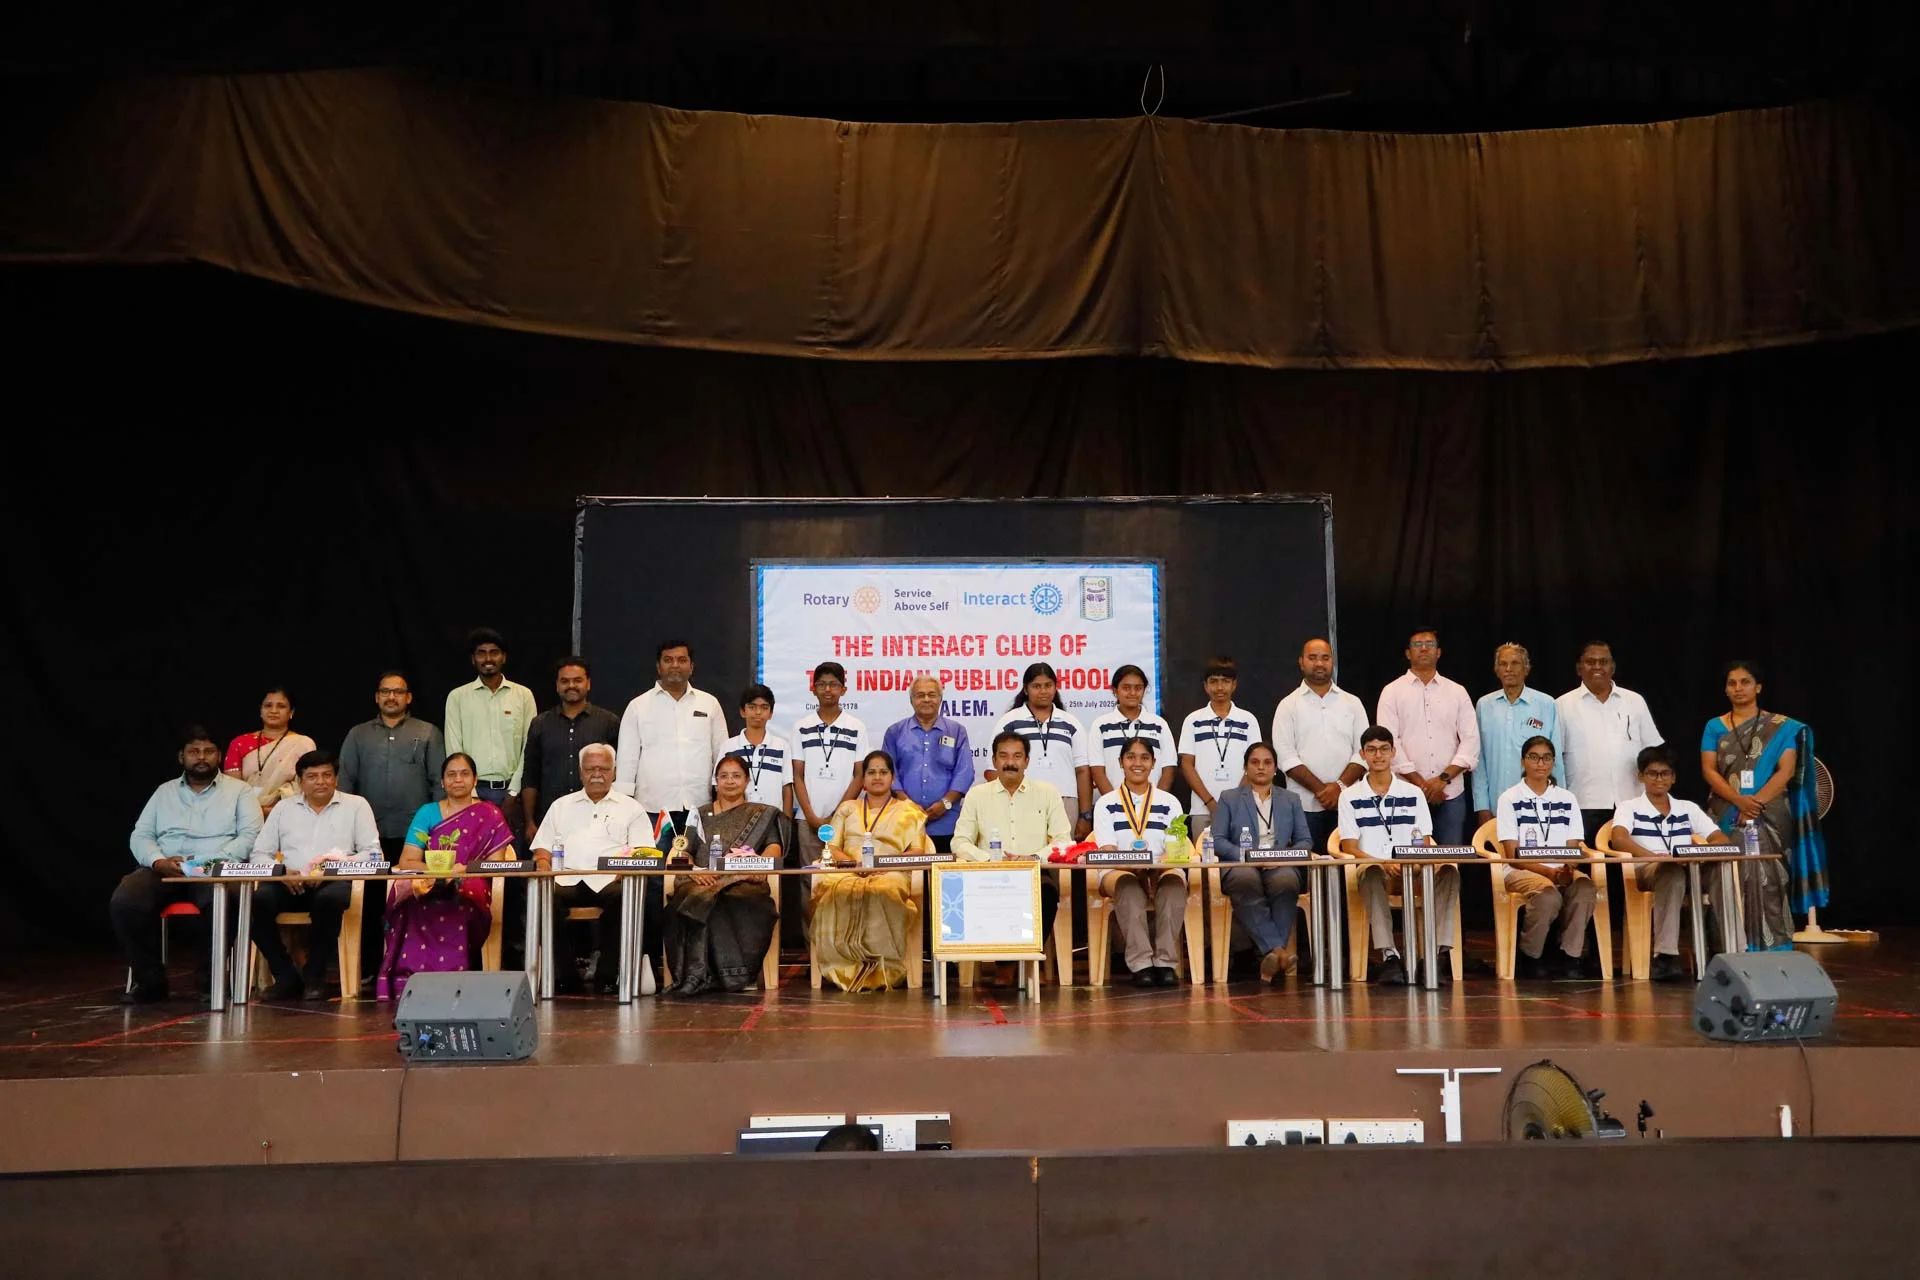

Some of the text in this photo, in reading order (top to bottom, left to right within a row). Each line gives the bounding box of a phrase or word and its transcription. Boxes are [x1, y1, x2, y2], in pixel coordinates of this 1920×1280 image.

[894, 588, 932, 598] Service
[803, 593, 850, 608] Rotary
[963, 591, 1027, 606] Interact
[894, 601, 950, 611] Above Self
[832, 634, 1088, 657] THE INTERACT CLUB OF
[939, 668, 1019, 691] PUBLIC
[1069, 700, 1084, 708] 25th
[1084, 700, 1098, 709] July
[1249, 849, 1308, 859] VICE PRINCIPAL
[1413, 847, 1431, 855] VICE
[1432, 846, 1474, 855] PRESIDENT
[918, 854, 954, 862] HONOUR
[1107, 852, 1150, 861] PRESIDENT
[325, 860, 390, 869] INTERACT CHAIR
[480, 861, 522, 869] PRINCIPAL
[607, 859, 657, 867] CHIEF GUEST
